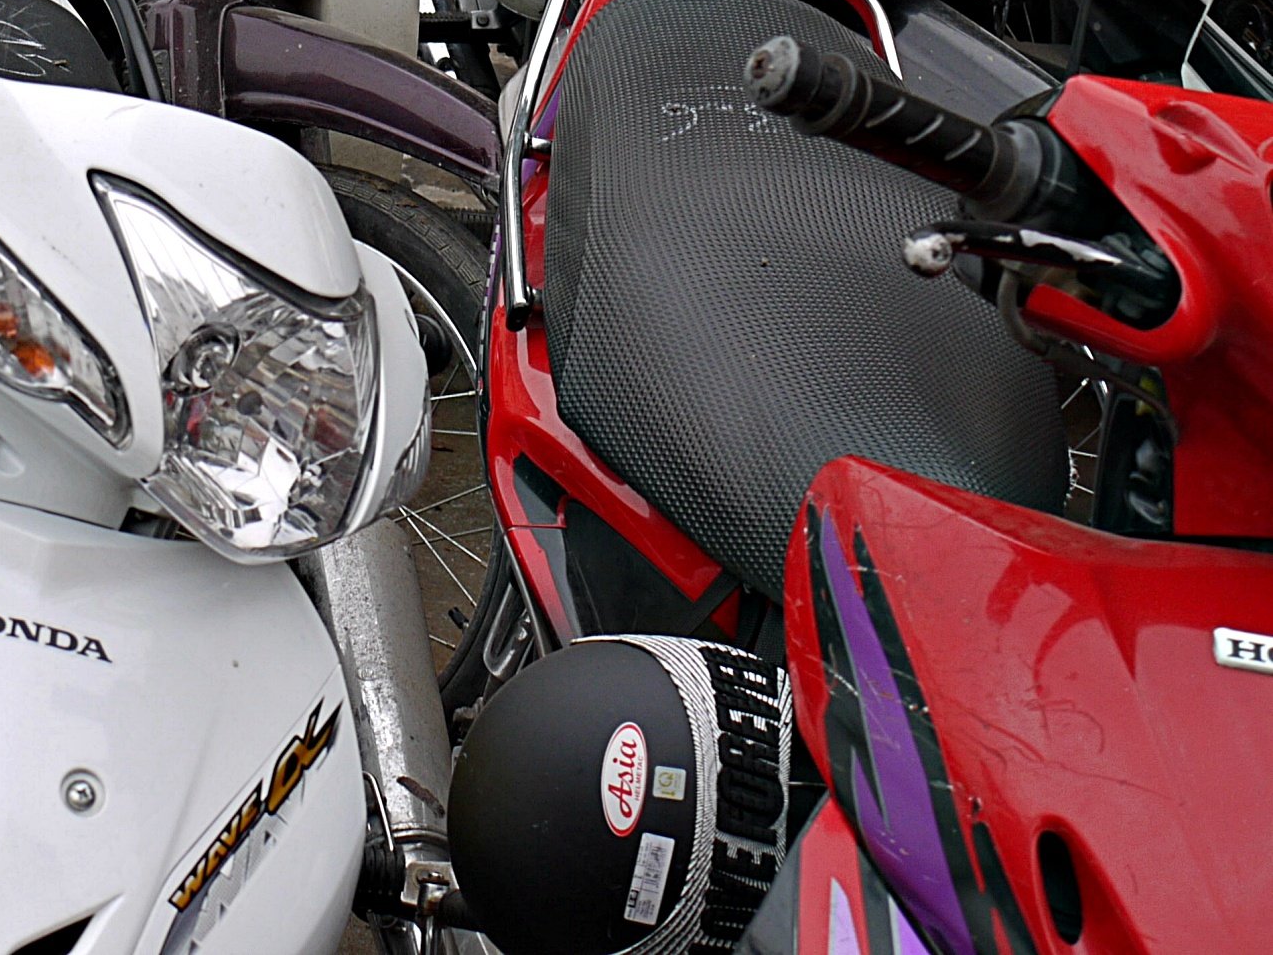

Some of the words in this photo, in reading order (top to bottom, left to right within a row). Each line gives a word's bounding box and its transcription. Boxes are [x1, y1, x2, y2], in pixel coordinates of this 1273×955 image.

[1227, 638, 1273, 662] H
[608, 739, 637, 819] Asia
[169, 779, 263, 912] WAVE
